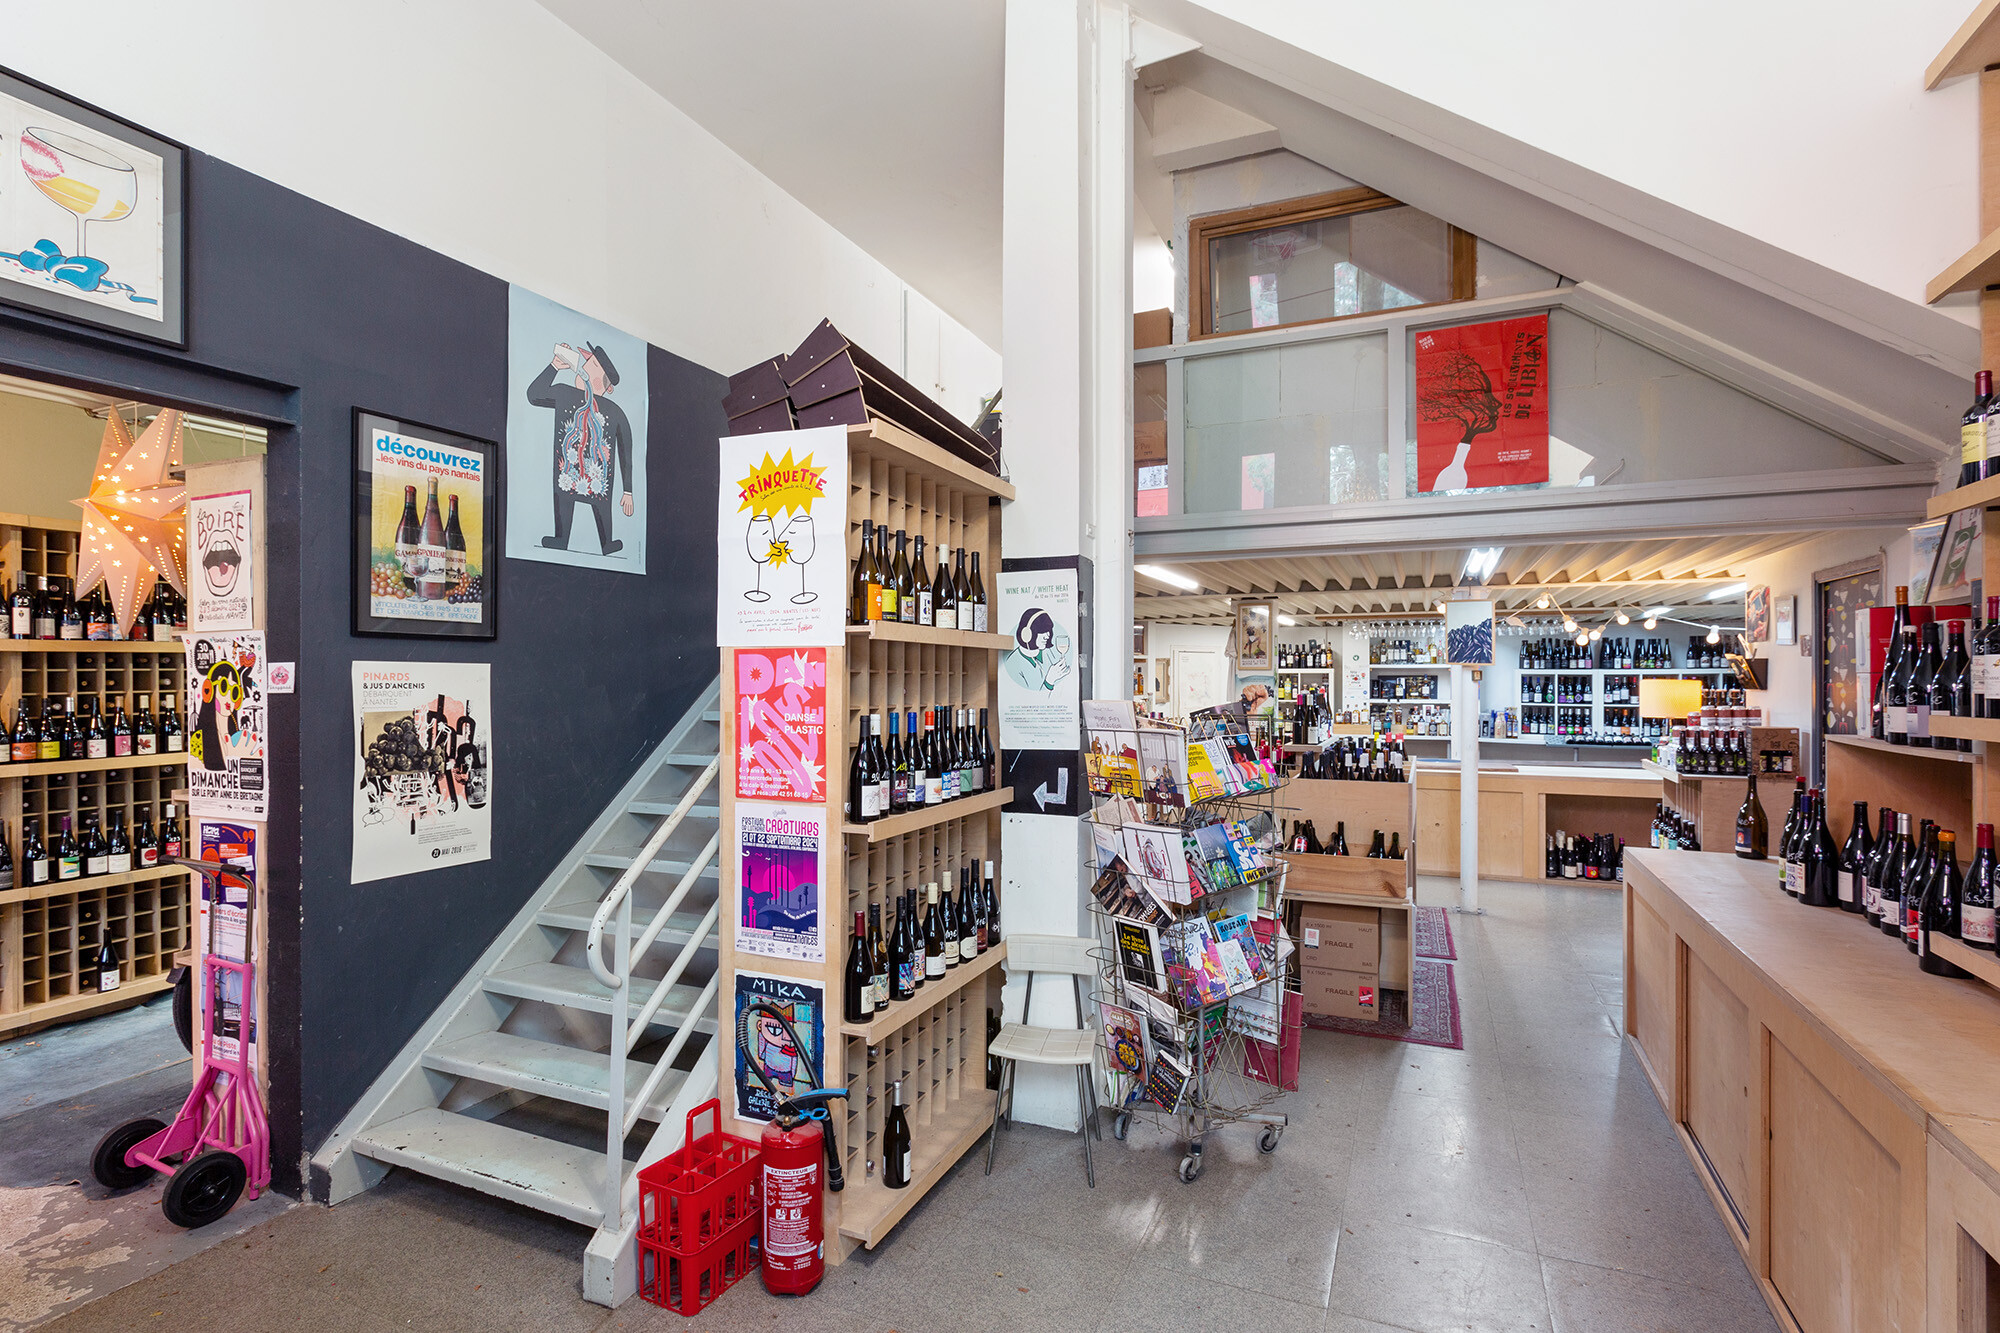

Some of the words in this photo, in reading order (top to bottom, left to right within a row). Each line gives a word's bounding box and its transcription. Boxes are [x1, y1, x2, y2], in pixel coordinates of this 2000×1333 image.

[1502, 403, 1512, 418] LES
[1515, 404, 1531, 419] DE
[376, 435, 480, 472] découvrez
[396, 457, 414, 469] vins
[415, 461, 427, 471] du
[429, 464, 449, 477] pays
[451, 469, 481, 482] nantais
[1021, 586, 1031, 594] NAT
[198, 643, 208, 652] 30
[363, 672, 410, 681] PINARDS
[784, 713, 816, 722] DANSE
[784, 725, 823, 735] PLASTIC
[227, 759, 238, 773] UN
[191, 789, 200, 797] SUR
[207, 790, 219, 798] PONT
[220, 791, 232, 799] ANNE
[233, 792, 239, 800] DE
[240, 792, 263, 801] BRETAGNE
[742, 833, 748, 841] 21
[757, 834, 765, 843] 22
[802, 837, 818, 848] 2024
[1220, 918, 1247, 933] KOSTAR
[1325, 940, 1354, 949] FRAGILE
[1325, 988, 1354, 996] FRAGILE
[771, 1168, 808, 1176] EXTINCTEUR
